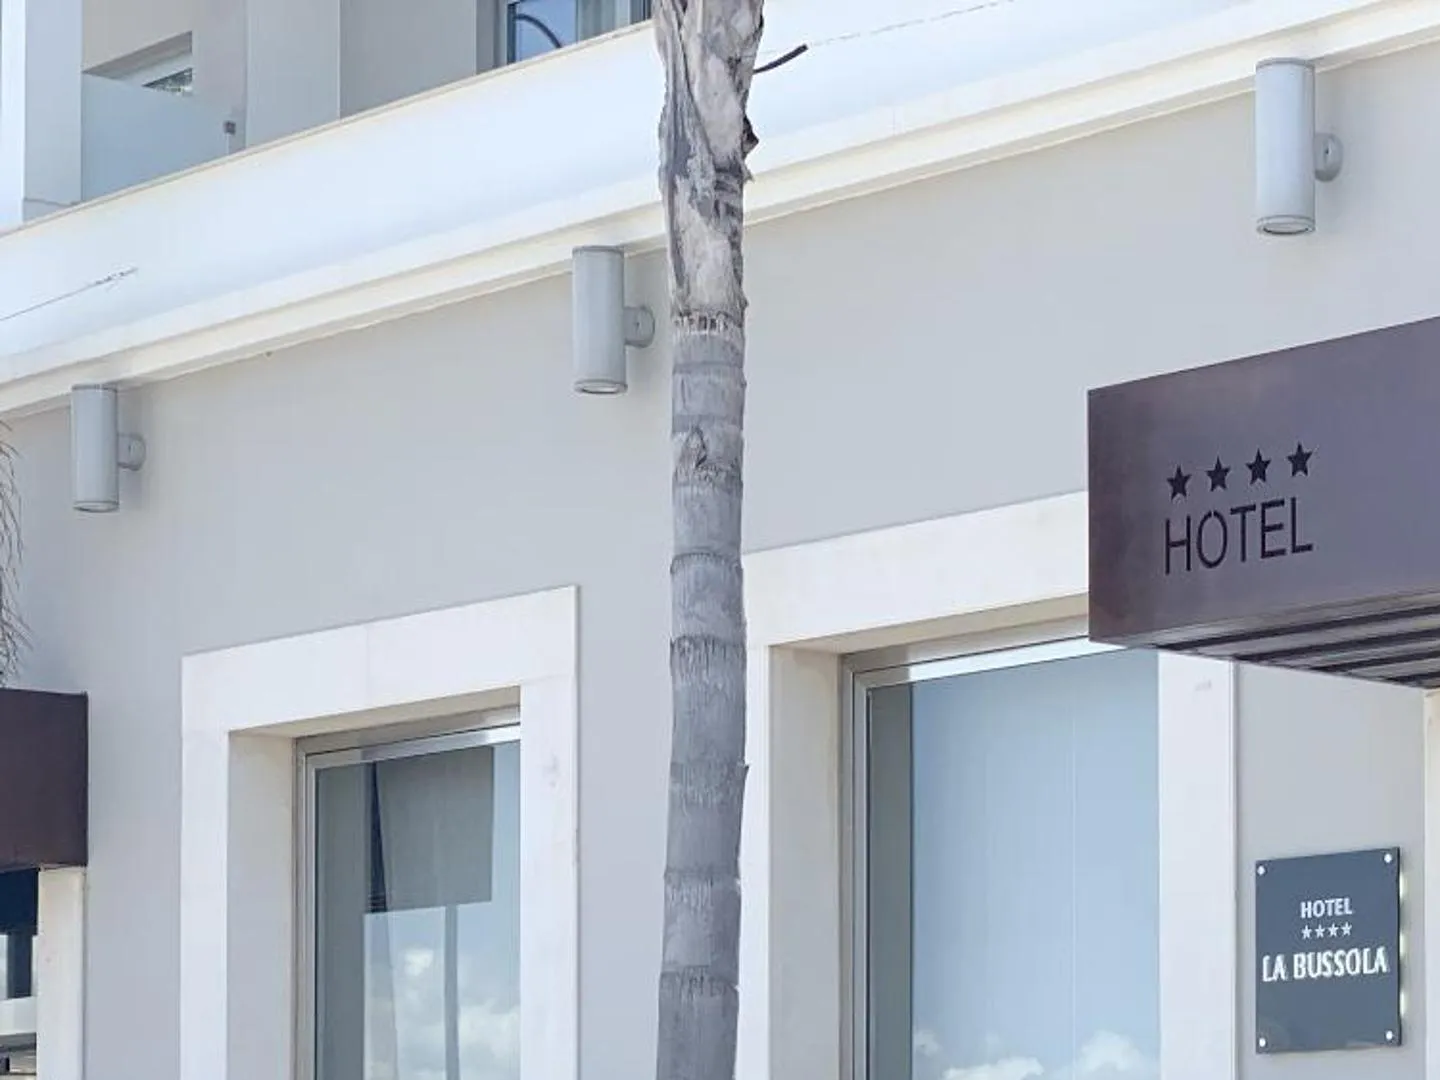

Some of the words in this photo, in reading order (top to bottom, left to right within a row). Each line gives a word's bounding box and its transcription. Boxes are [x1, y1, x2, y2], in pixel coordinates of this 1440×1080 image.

[1165, 496, 1313, 575] HOTEL
[1301, 897, 1353, 918] HOTEL
[1262, 954, 1287, 982] LA
[1293, 946, 1388, 980] BUSSOLA
